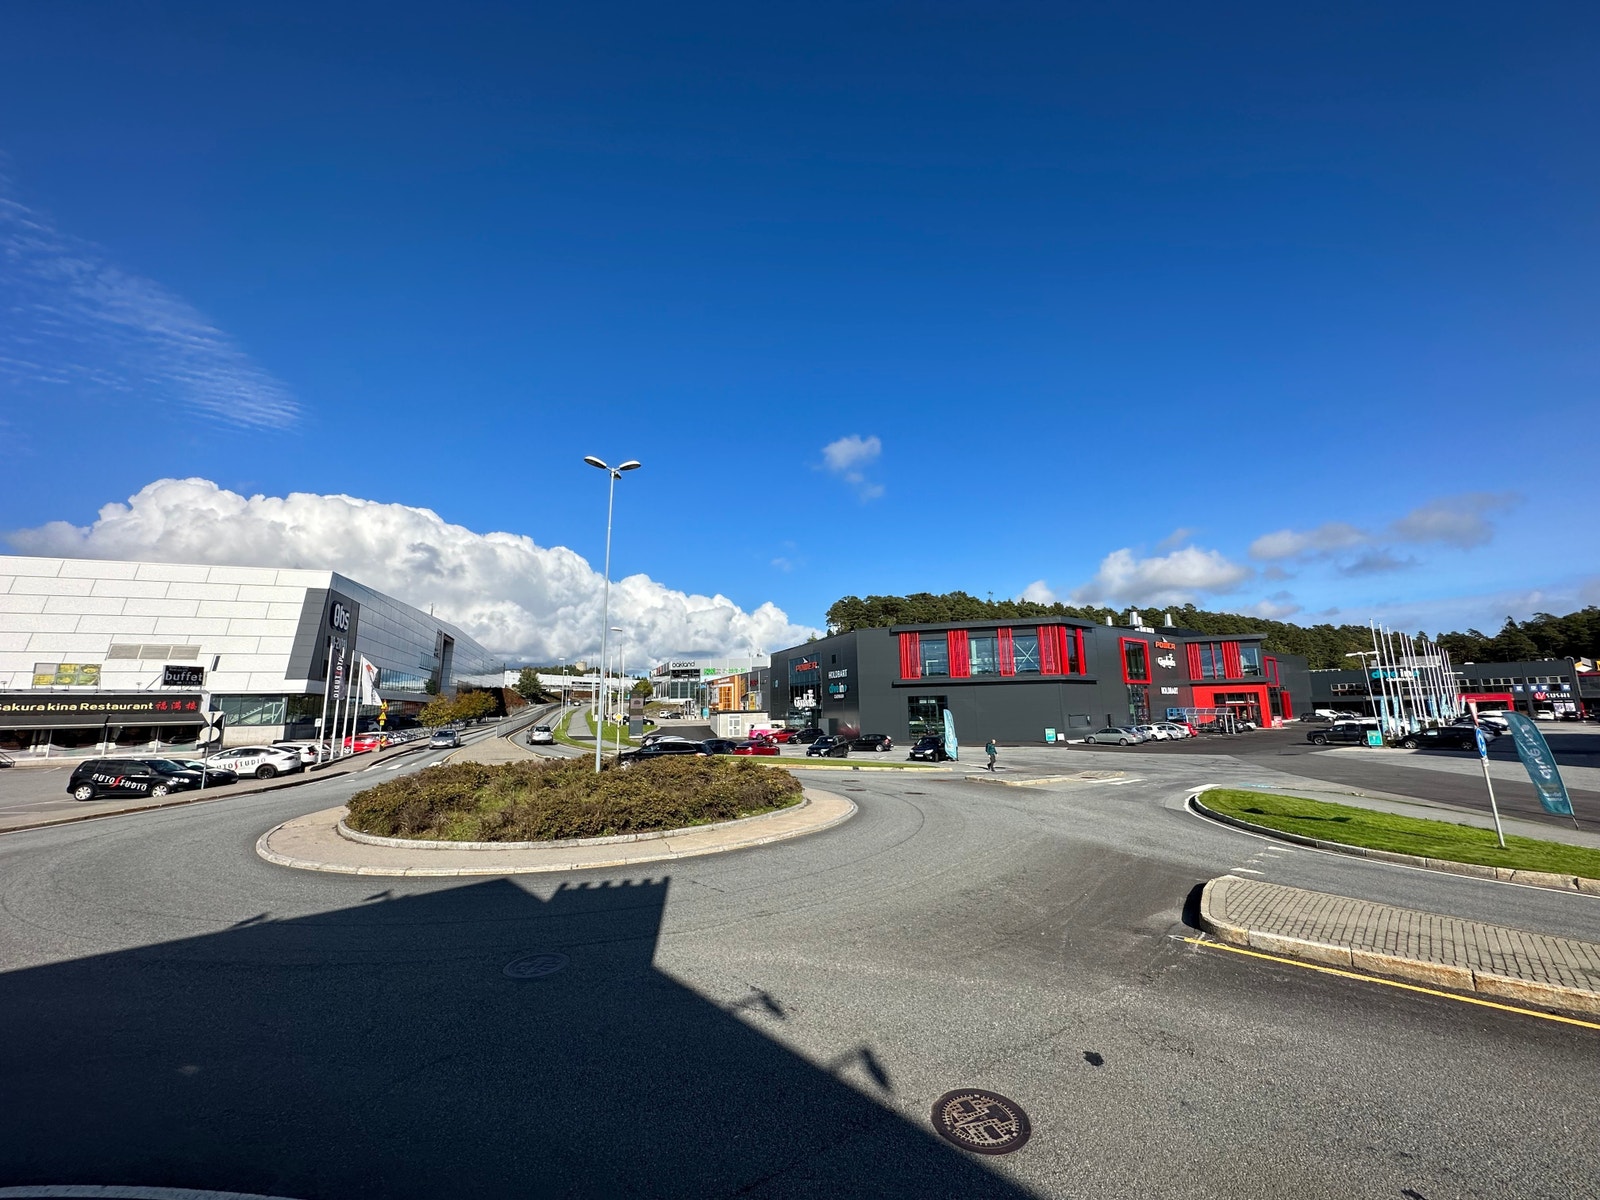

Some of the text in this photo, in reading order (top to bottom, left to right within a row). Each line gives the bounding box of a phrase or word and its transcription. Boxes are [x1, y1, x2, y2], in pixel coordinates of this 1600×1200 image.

[165, 670, 203, 682] buffet
[0, 702, 153, 711] akura kina Restaurant
